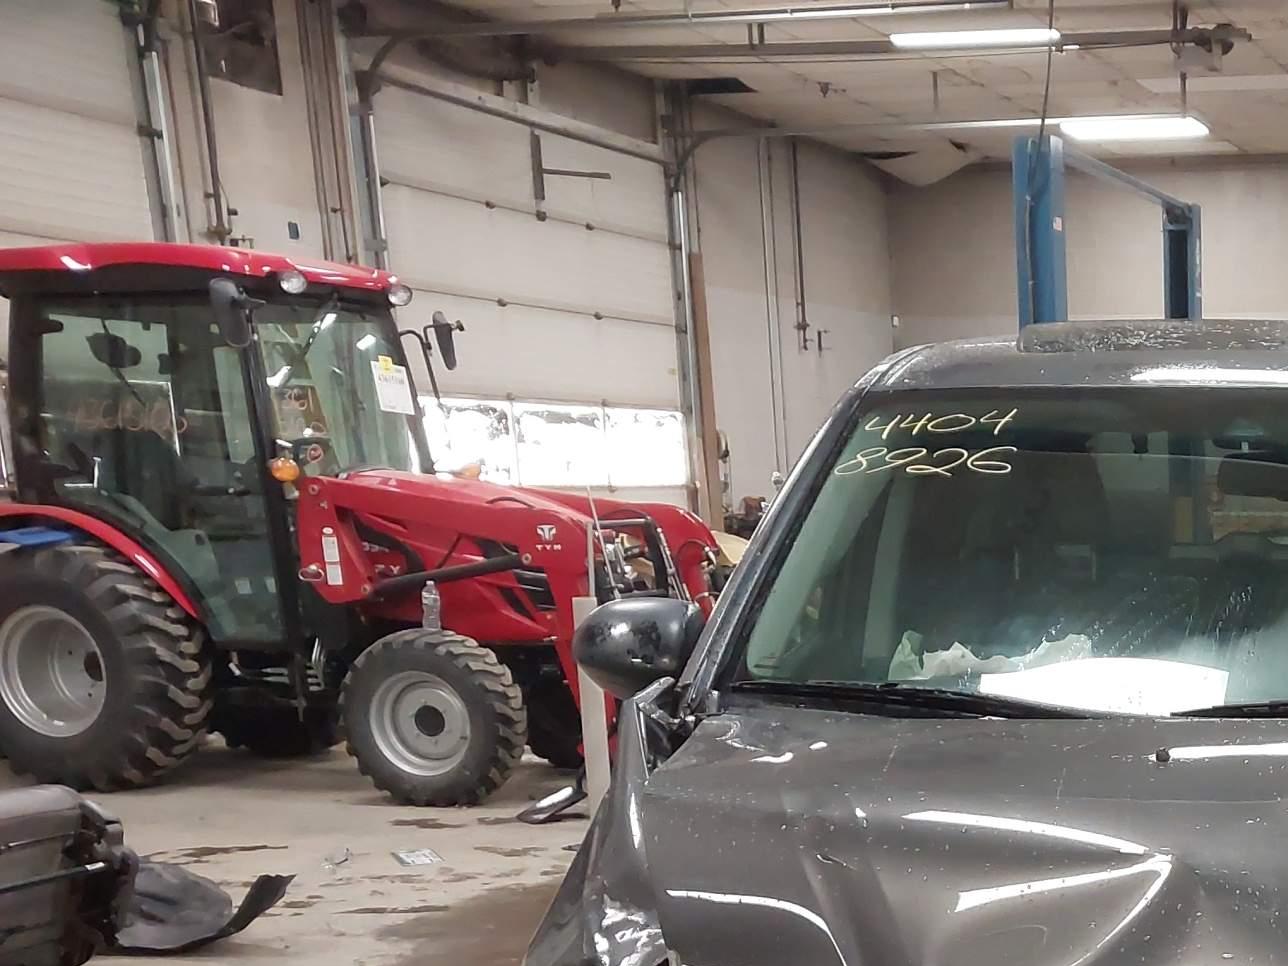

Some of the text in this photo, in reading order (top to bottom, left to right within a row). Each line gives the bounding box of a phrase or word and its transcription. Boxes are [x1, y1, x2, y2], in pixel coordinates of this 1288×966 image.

[864, 408, 1018, 440] 4404
[834, 446, 1018, 477] 8926
[535, 543, 562, 552] TYM
